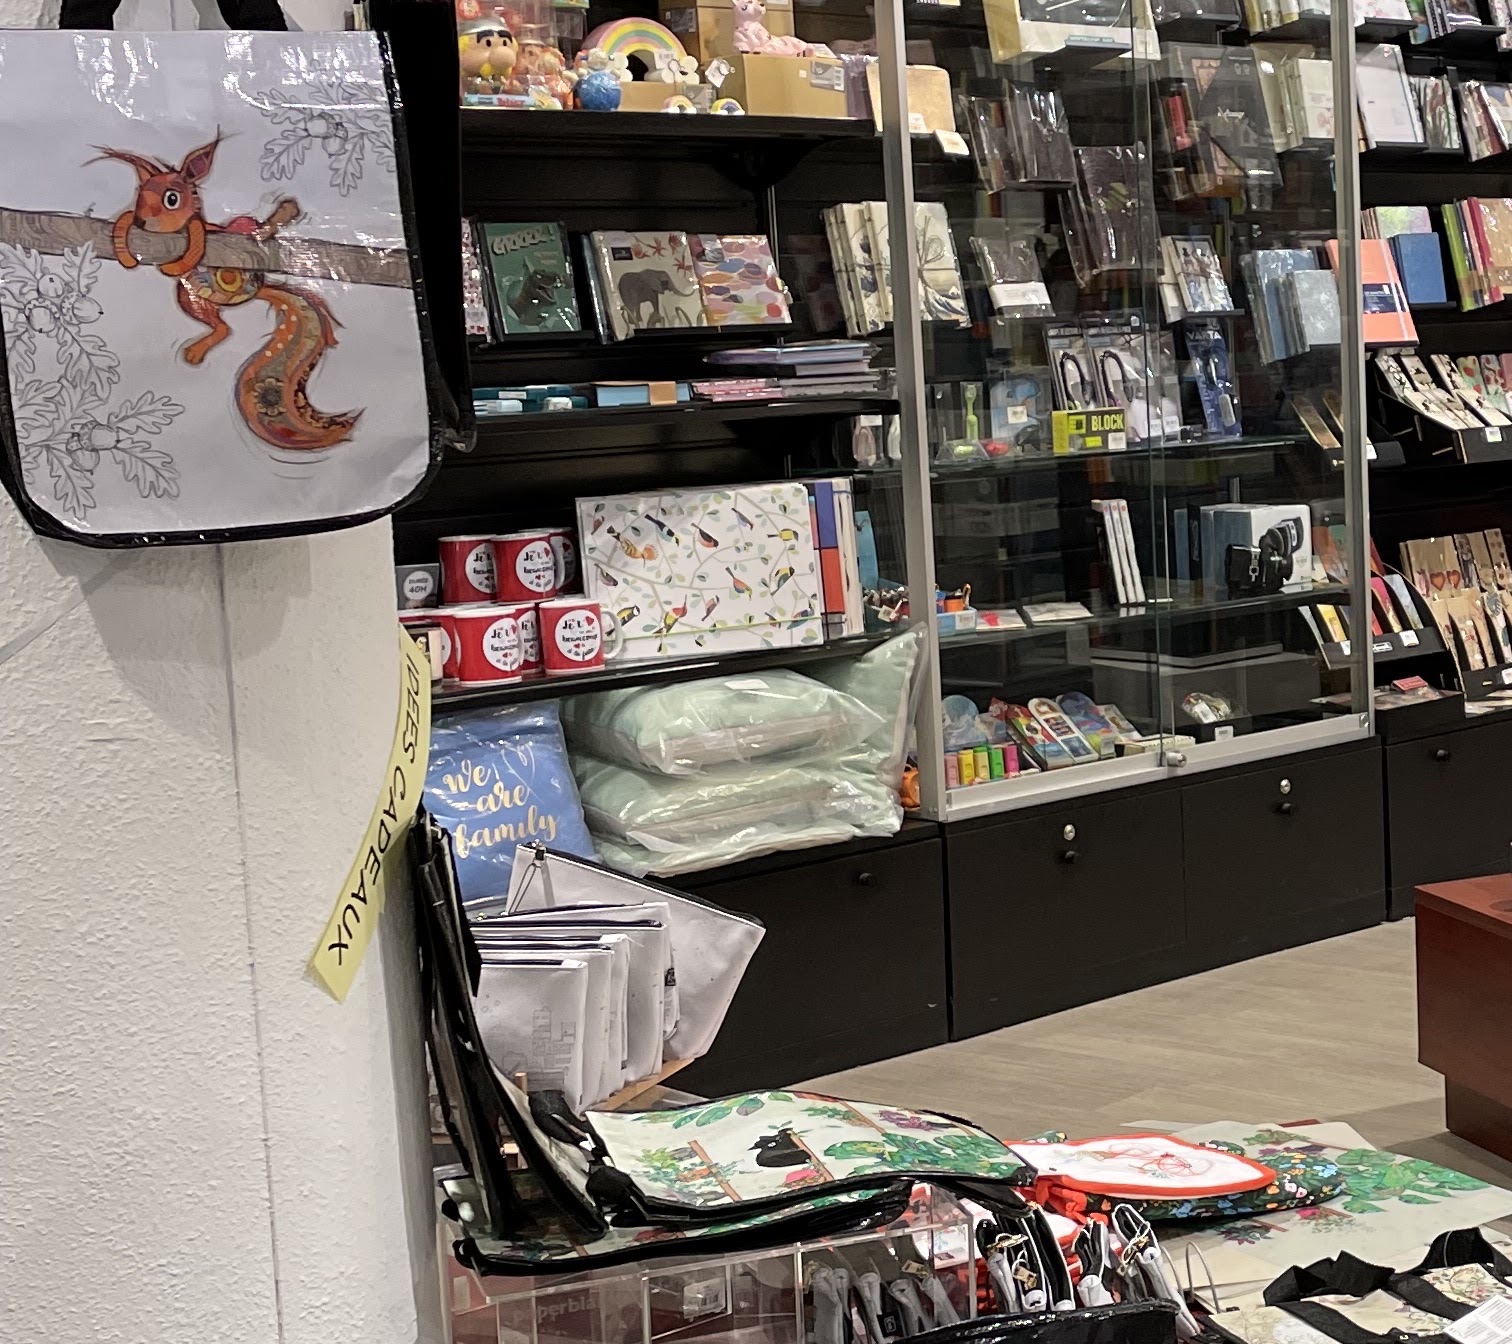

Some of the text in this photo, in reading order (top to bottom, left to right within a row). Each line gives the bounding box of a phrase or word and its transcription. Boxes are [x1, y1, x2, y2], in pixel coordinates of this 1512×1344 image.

[1185, 329, 1222, 341] VARTA
[1091, 412, 1125, 431] BLOCK
[402, 652, 420, 764] IDEES
[474, 780, 531, 813] are
[453, 805, 561, 859] family
[327, 765, 407, 967] CADEAUX
